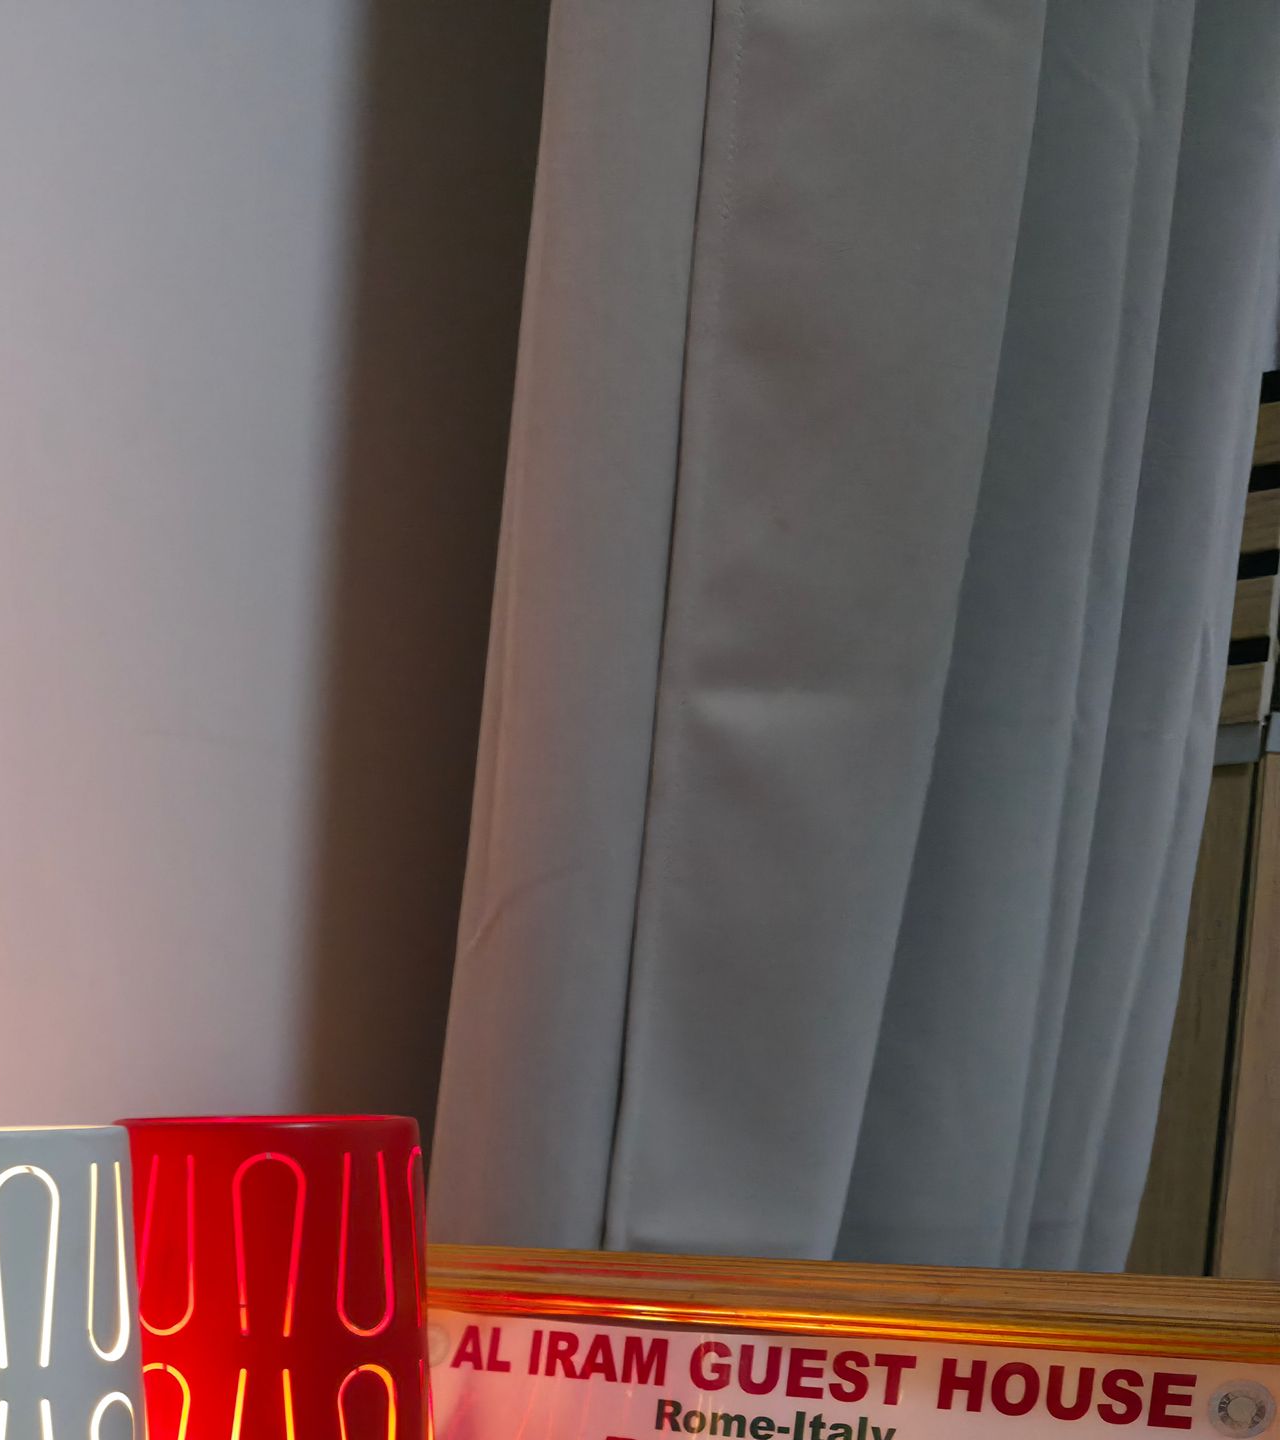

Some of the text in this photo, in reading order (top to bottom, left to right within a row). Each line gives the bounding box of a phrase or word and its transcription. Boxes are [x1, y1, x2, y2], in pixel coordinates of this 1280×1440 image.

[450, 1325, 1197, 1430] AL IRAM GUEST HOUSE
